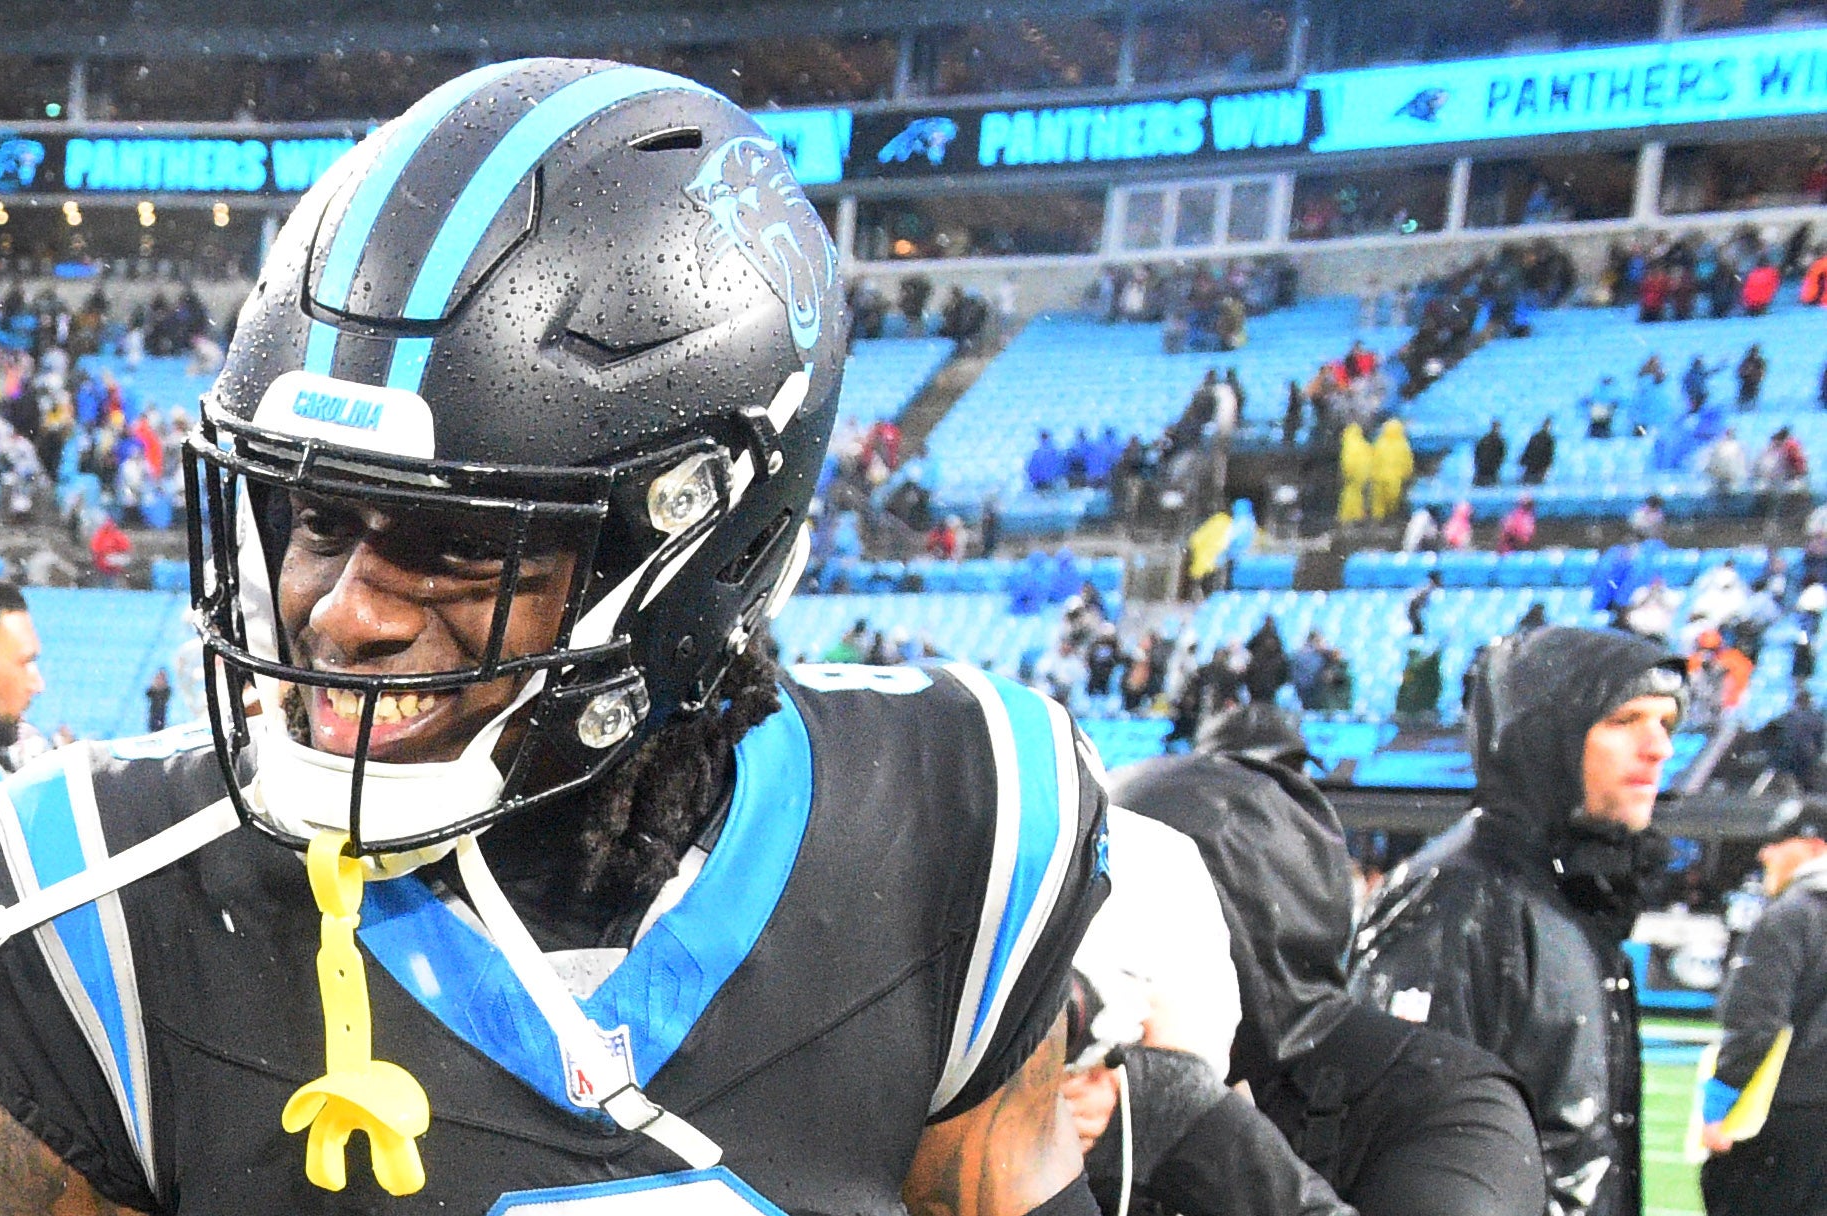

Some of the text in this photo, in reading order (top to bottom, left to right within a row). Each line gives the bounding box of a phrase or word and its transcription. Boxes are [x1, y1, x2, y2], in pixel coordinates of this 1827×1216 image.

[1486, 58, 1732, 118] PANTHERS
[978, 88, 1310, 167] PANTHERS WIN
[64, 138, 268, 191] PANTHERS
[291, 389, 385, 432] CAROLINA
